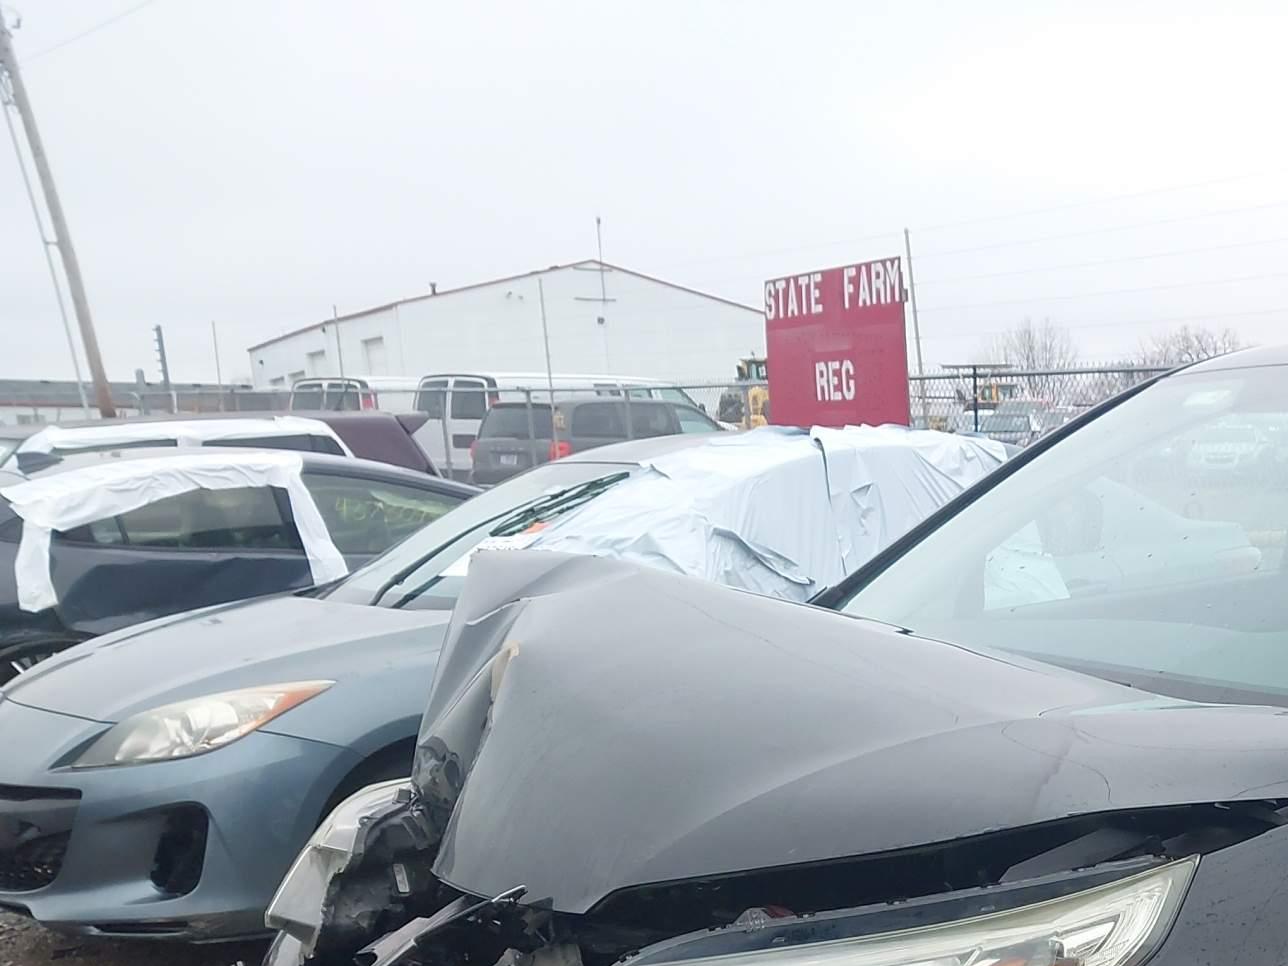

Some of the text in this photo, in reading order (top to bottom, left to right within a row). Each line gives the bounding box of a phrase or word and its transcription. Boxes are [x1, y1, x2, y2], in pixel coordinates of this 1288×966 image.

[765, 259, 900, 320] STATE FARM
[815, 359, 856, 401] REG
